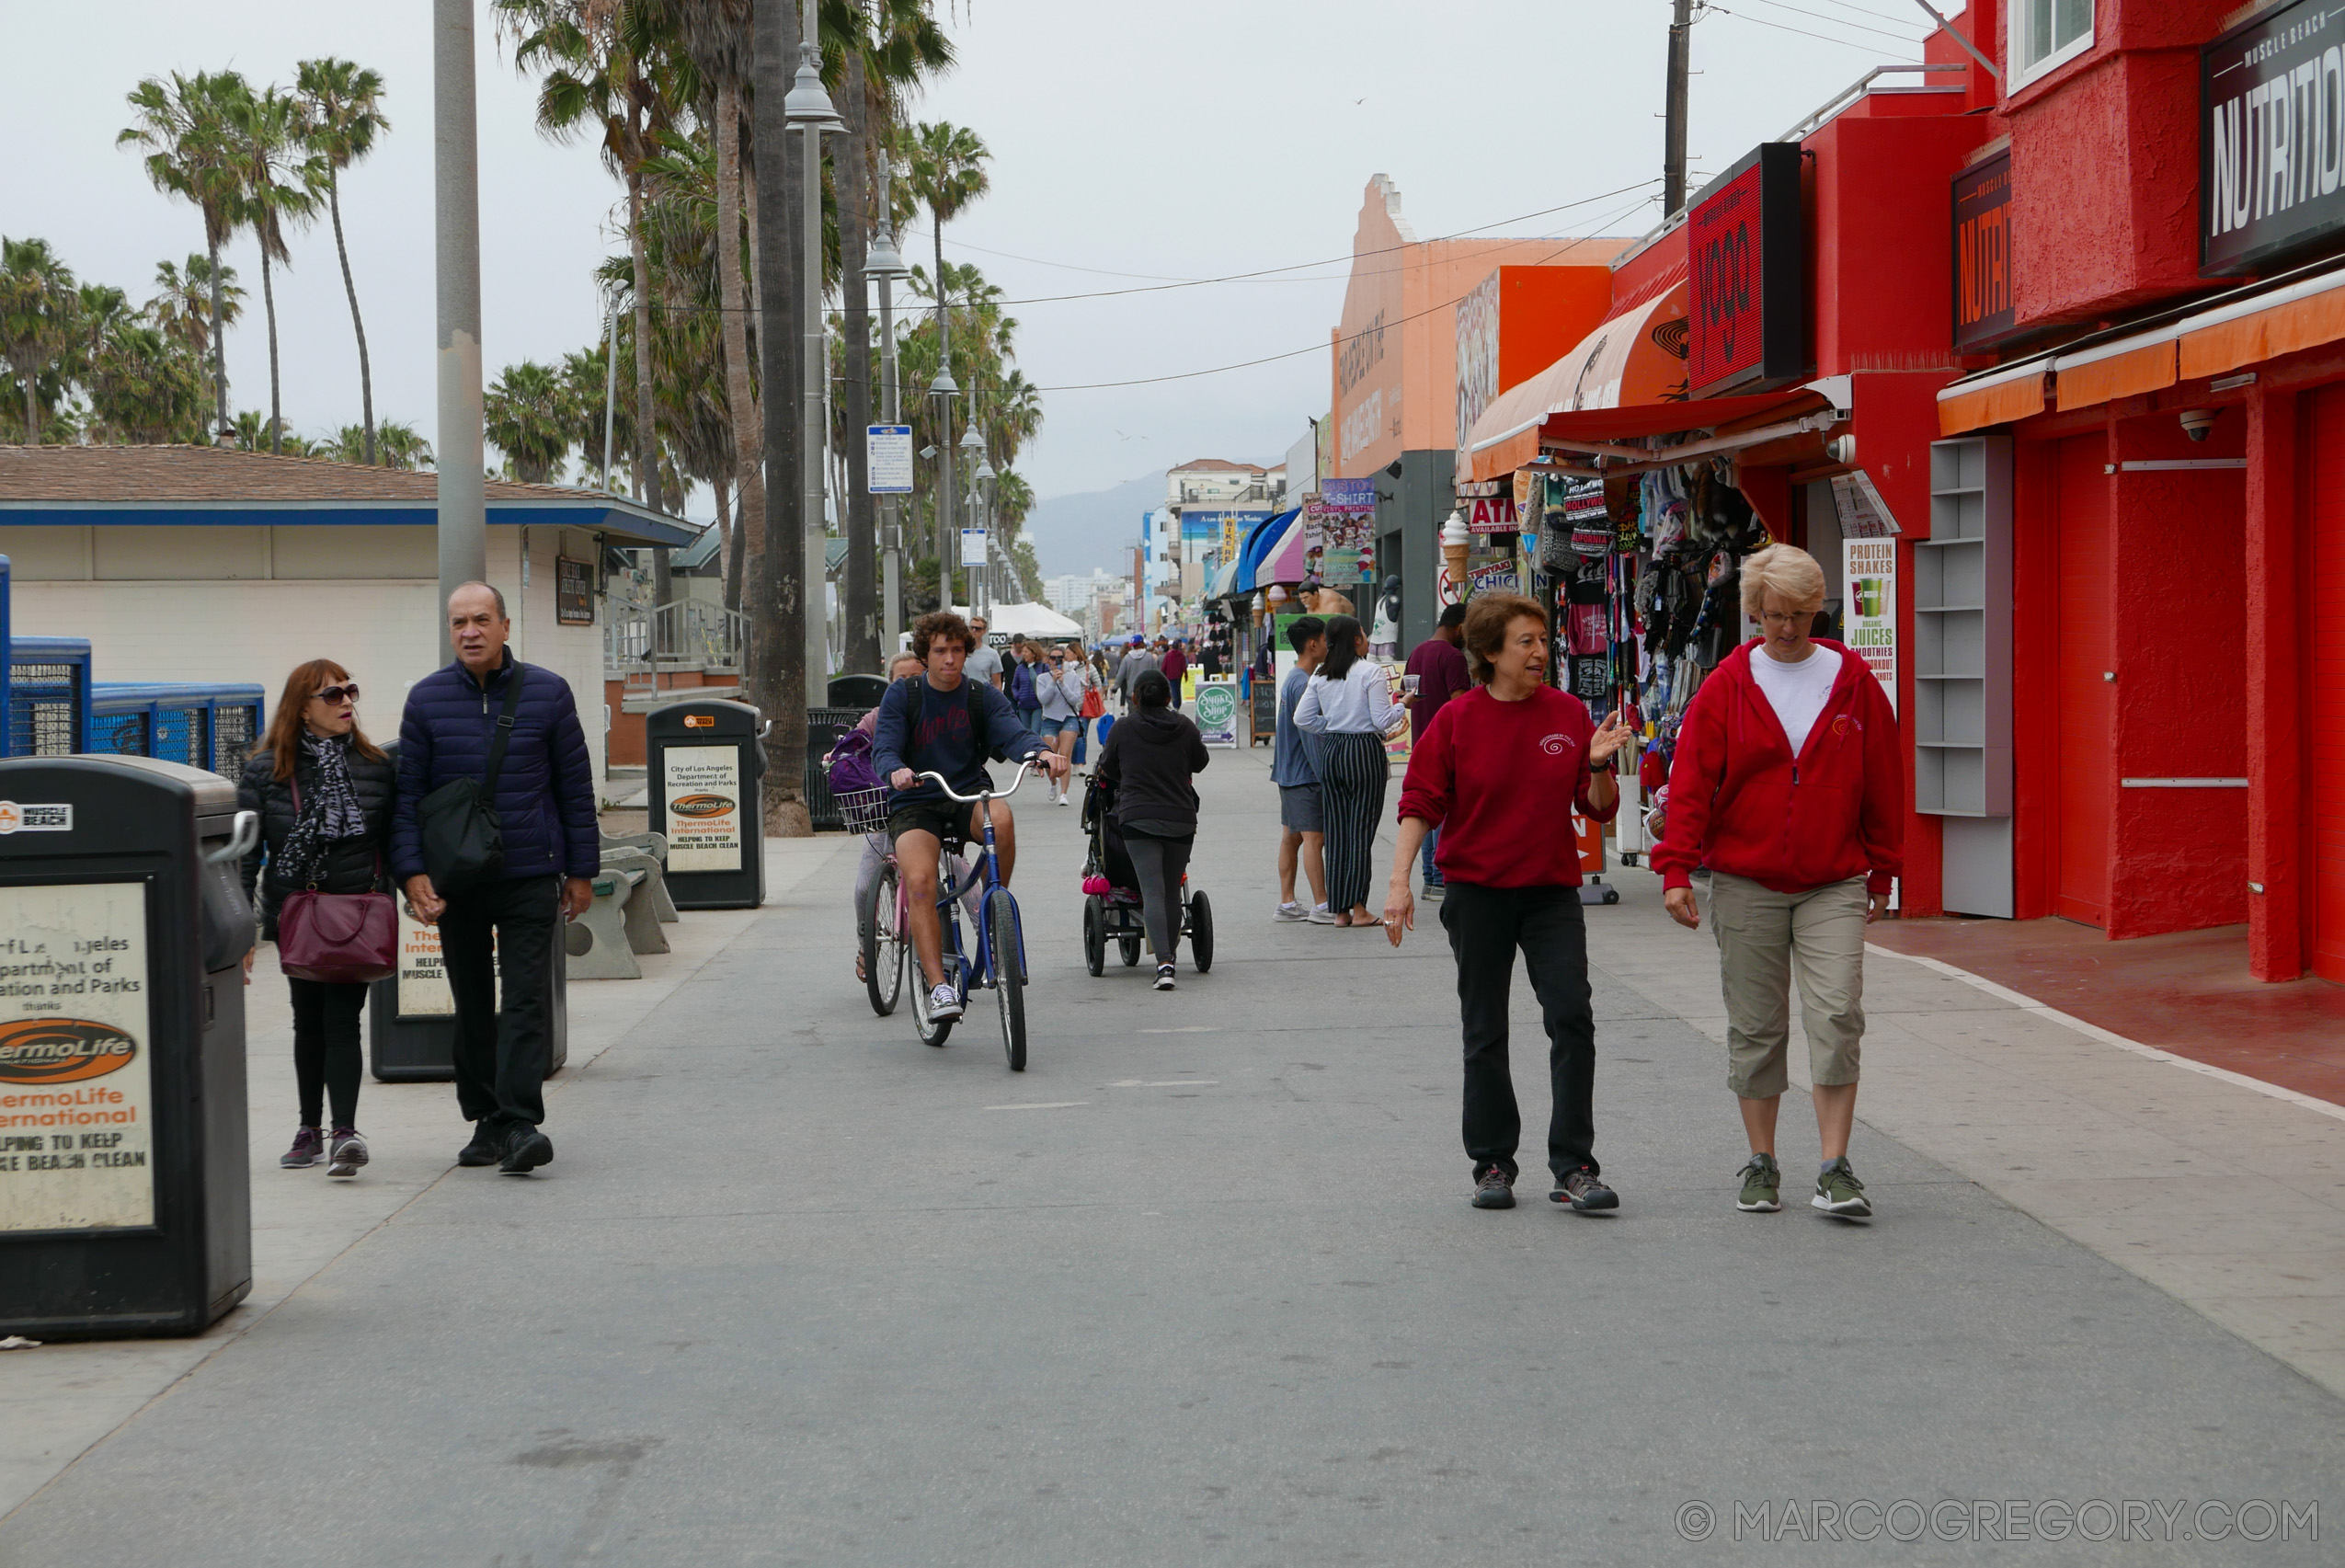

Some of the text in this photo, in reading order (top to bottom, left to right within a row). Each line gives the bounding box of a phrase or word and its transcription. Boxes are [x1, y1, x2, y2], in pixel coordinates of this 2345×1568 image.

[2245, 11, 2327, 69] MUSCLE BEACH
[2212, 43, 2345, 237] NUTRITIO
[1978, 174, 2002, 199] MUSCLE
[1324, 479, 1375, 493] CUSTOM
[1324, 492, 1374, 505] T-SHIRT
[1225, 521, 1233, 546] BIKE
[1471, 525, 1507, 533] AVAILABLE
[1850, 544, 1893, 559] PROTEIN
[1469, 560, 1511, 579] TERIYAKI
[1850, 560, 1893, 574] SHAKES
[1851, 628, 1893, 646] JUICES
[706, 764, 733, 773] Angeles
[672, 801, 733, 810] ThermoLife
[676, 819, 731, 828] ThermoLife
[93, 957, 113, 974] of
[403, 969, 442, 979] MUSCLE
[50, 978, 86, 995] and
[91, 977, 141, 994] Parks
[23, 1001, 62, 1011] thanks
[51, 1134, 72, 1150] TO
[80, 1132, 122, 1149] KEEP
